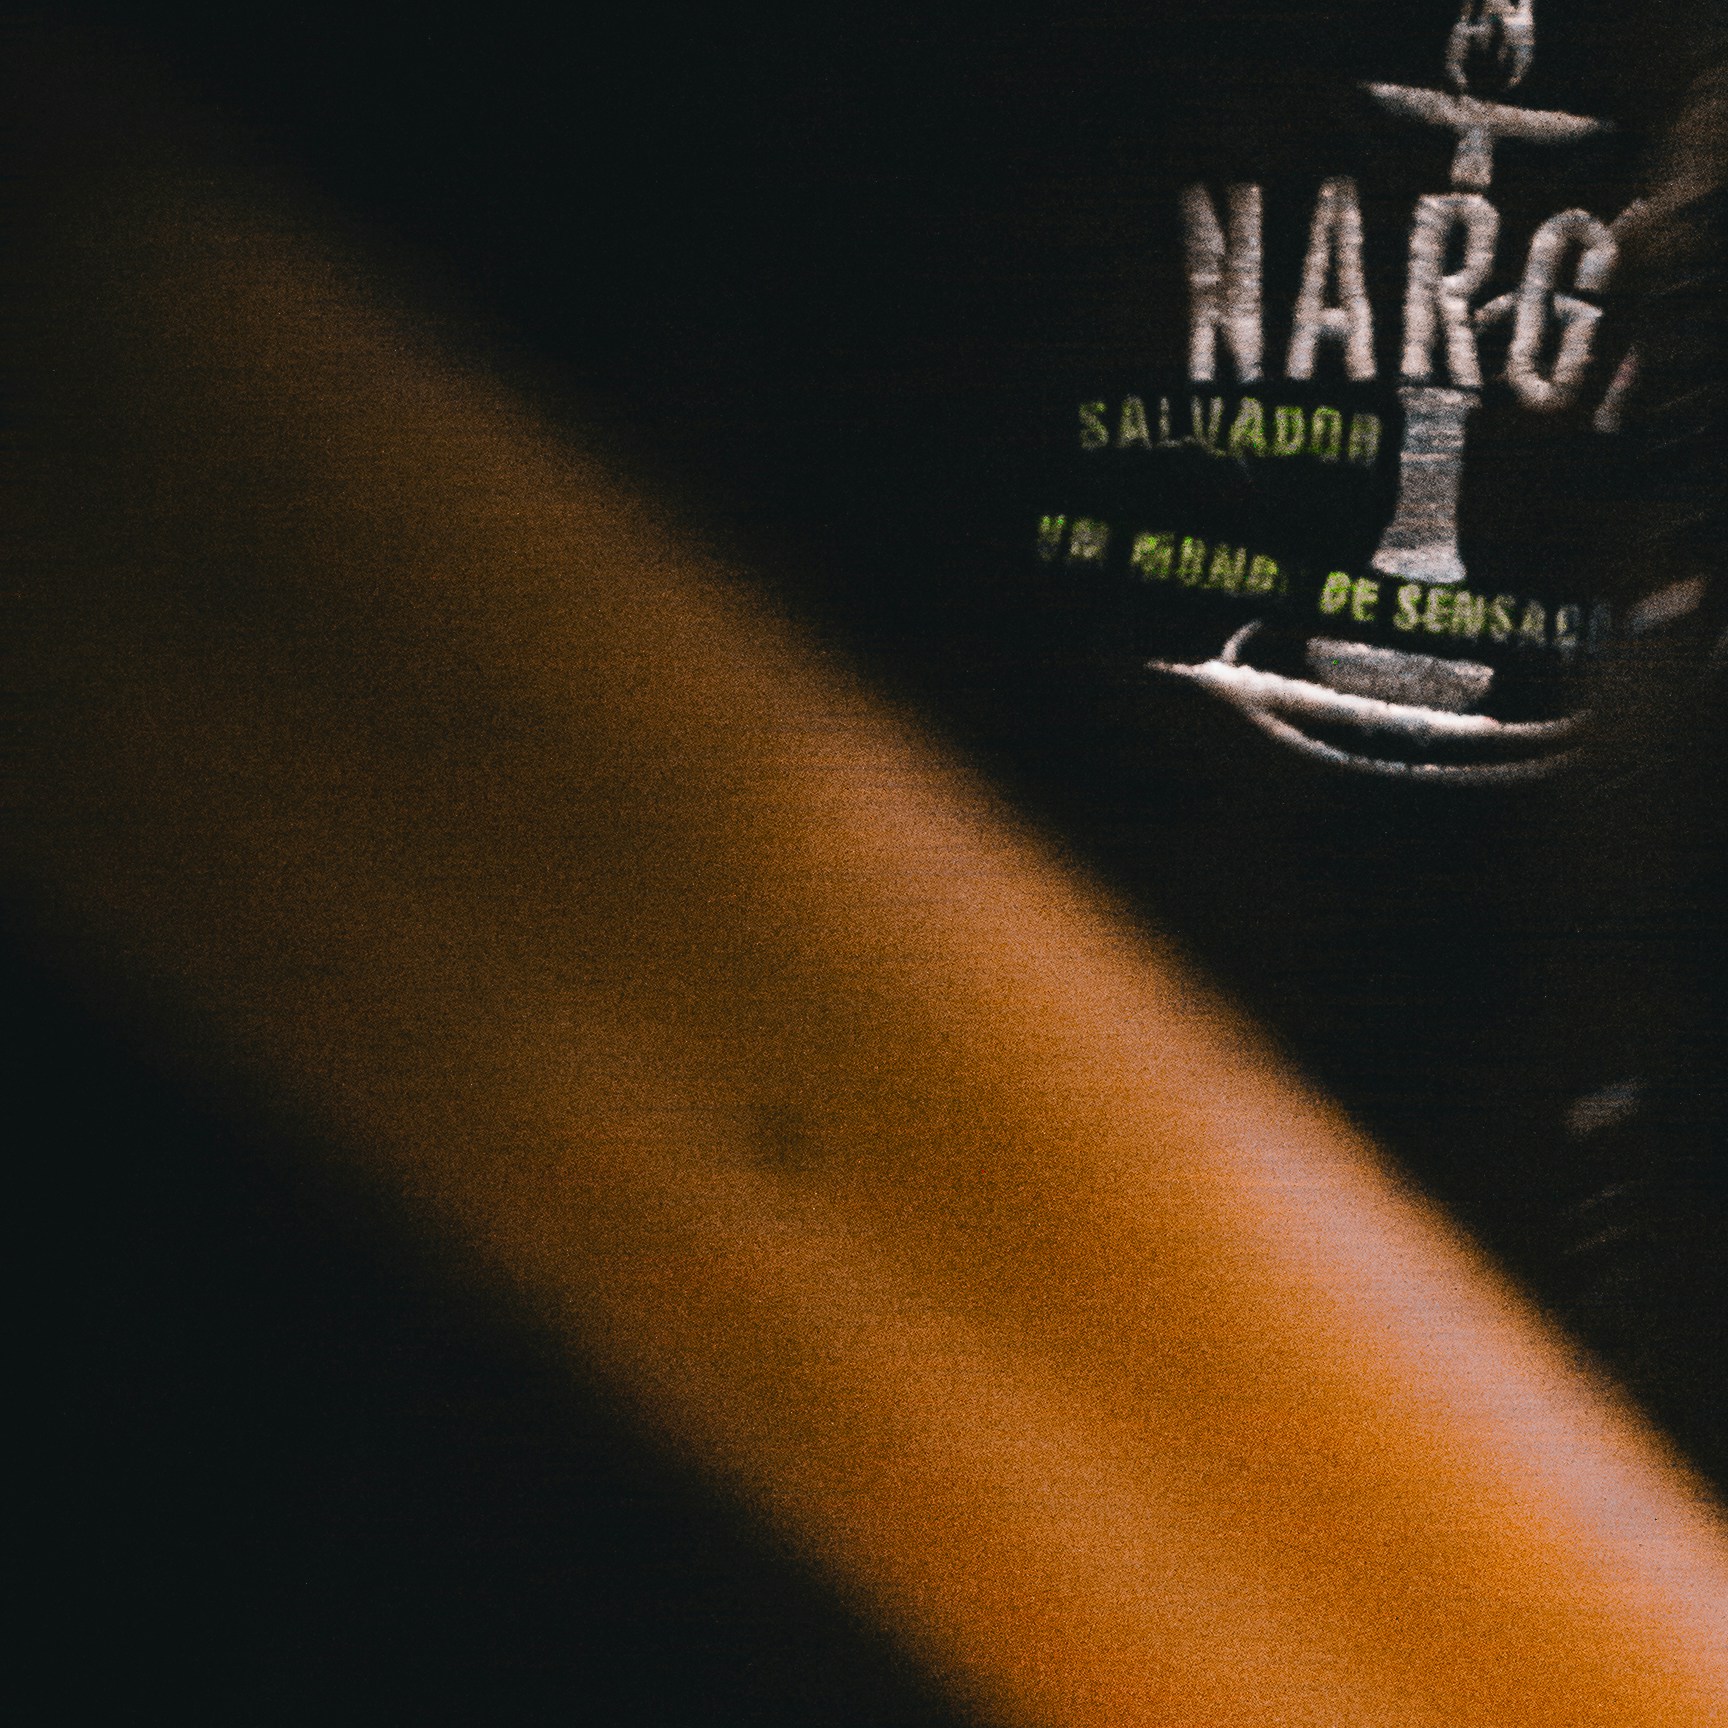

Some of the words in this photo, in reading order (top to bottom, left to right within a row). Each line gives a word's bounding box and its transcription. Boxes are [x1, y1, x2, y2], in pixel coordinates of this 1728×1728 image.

[1183, 176, 1640, 434] NARG
[1077, 394, 1384, 467] SALVADOR
[1130, 529, 1289, 598] MUND
[1318, 570, 1381, 624] DE
